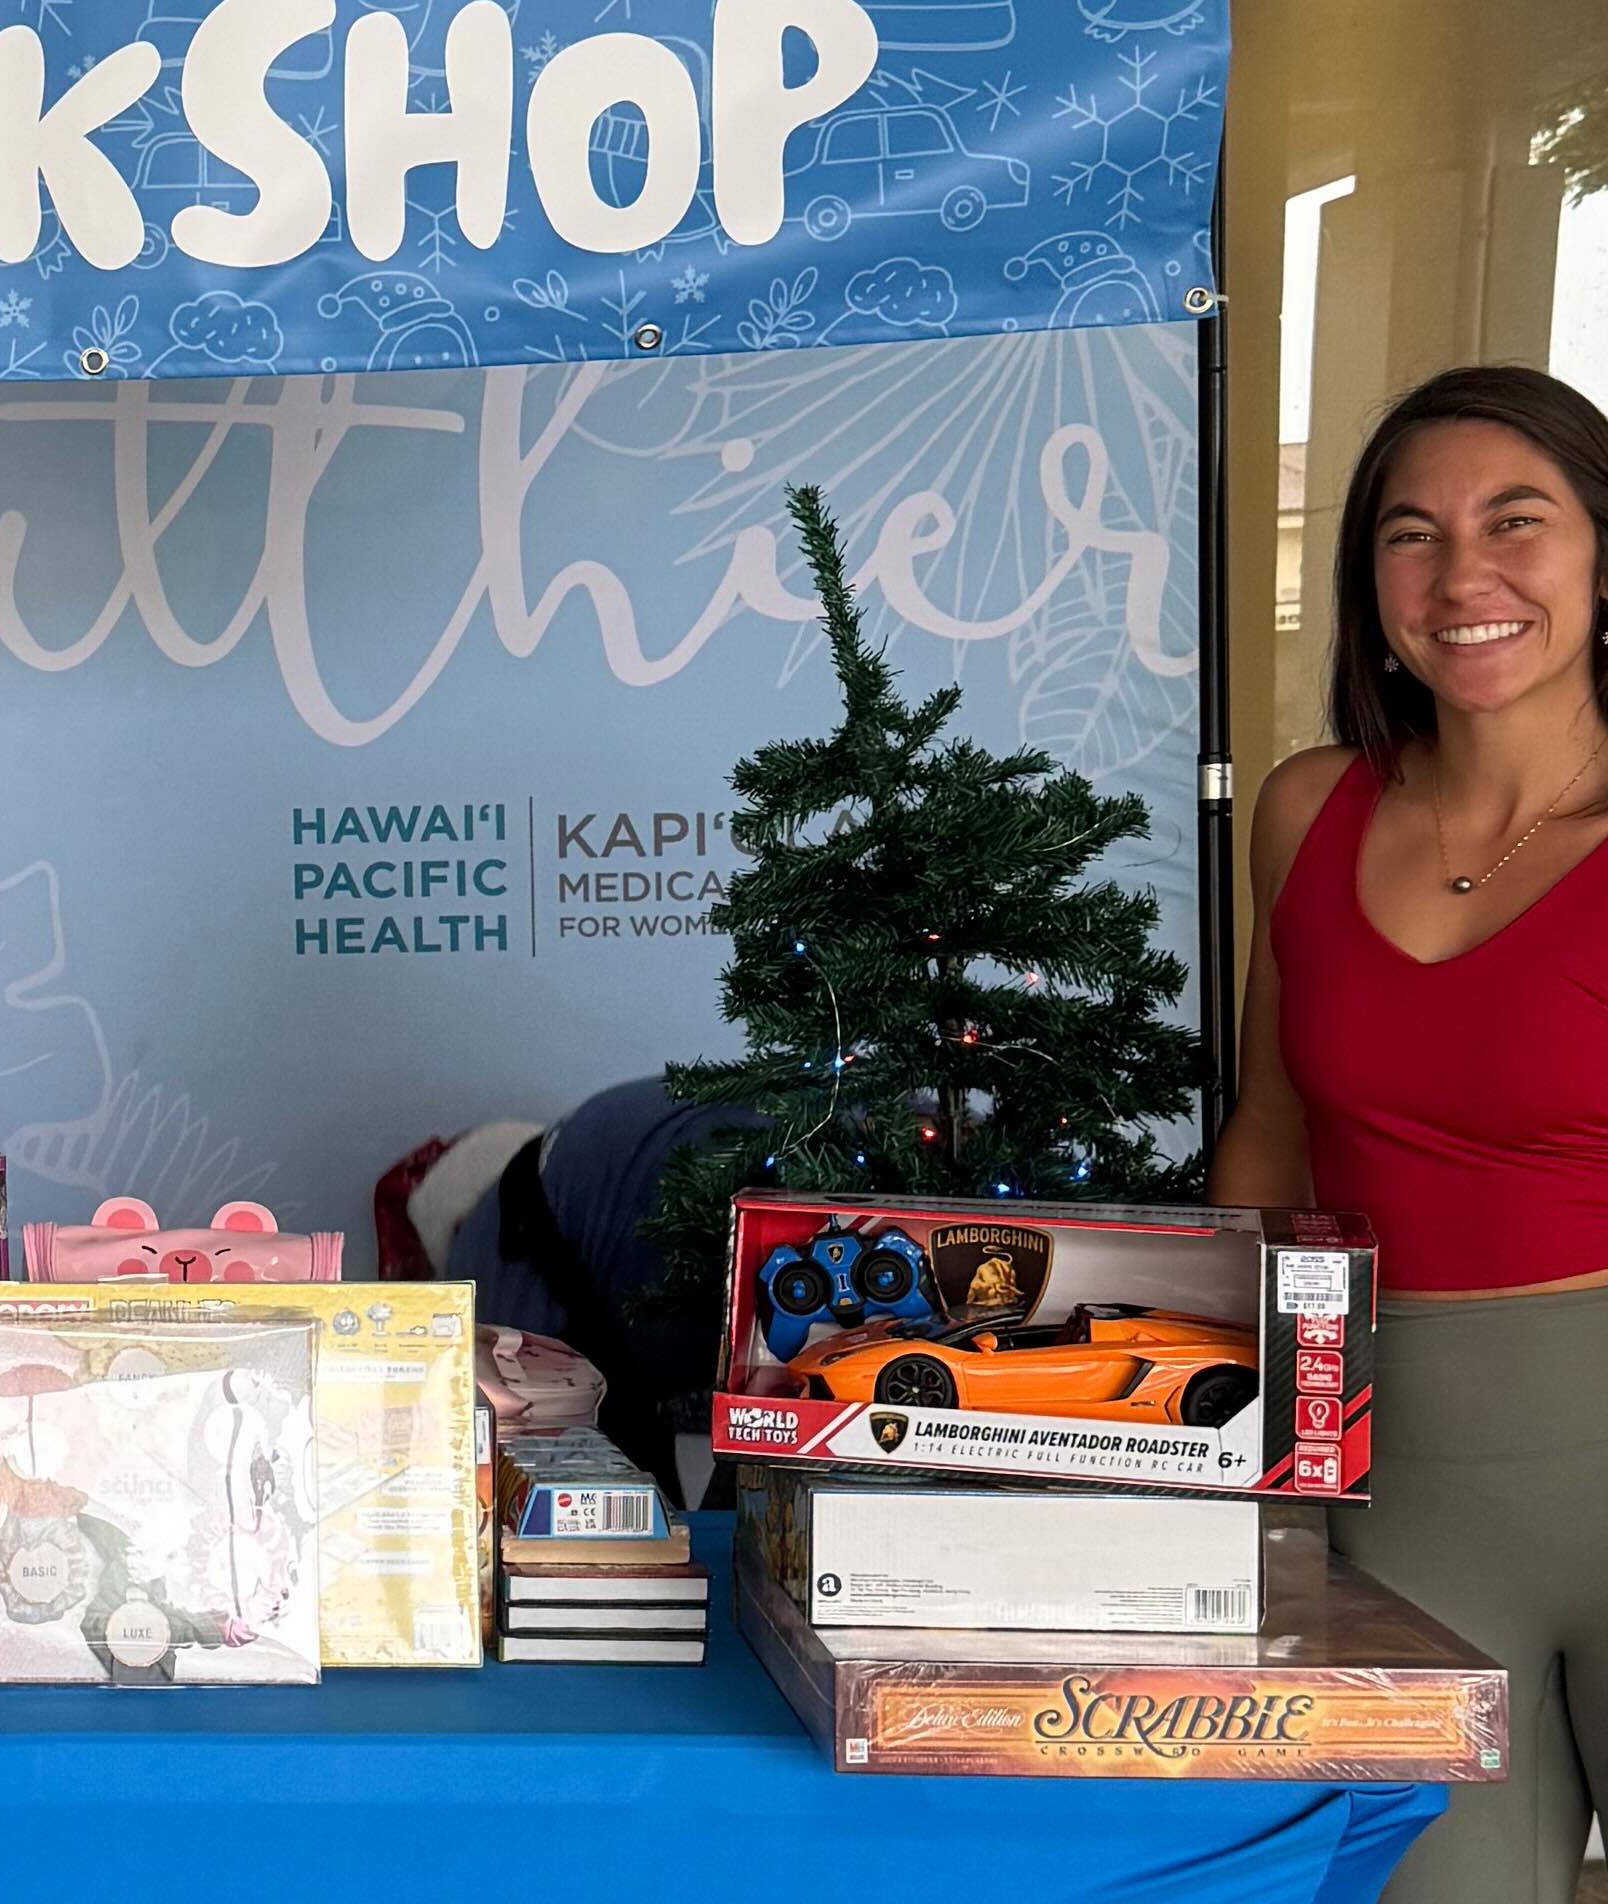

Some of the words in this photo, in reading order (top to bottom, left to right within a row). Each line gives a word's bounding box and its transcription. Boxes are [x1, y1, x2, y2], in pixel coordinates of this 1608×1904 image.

[294, 858, 508, 900] PACIFIC
[559, 870, 728, 903] MEDICA
[295, 914, 508, 955] HEALTH
[560, 916, 621, 938] FOR
[634, 915, 727, 937] WOM
[937, 1227, 1044, 1253] LAMBORGHINI
[729, 1408, 799, 1429] WORLD
[729, 1427, 761, 1441] TECH
[765, 1429, 798, 1445] TOYS
[914, 1421, 1025, 1445] LAMBORGHINI
[1028, 1429, 1122, 1452] AVENTADOR
[1125, 1438, 1210, 1458] ROADSTER
[914, 1442, 943, 1453] 1:14
[951, 1444, 1018, 1459] ELECTRIC
[1027, 1451, 1061, 1463] FULL
[1070, 1453, 1142, 1469] FUNCTION
[1151, 1459, 1168, 1472] RC
[1177, 1462, 1205, 1474] CAR
[1217, 1451, 1248, 1469] 6+
[22, 1566, 57, 1577] BASIC
[123, 1628, 152, 1639] LUXE
[962, 1705, 1024, 1728] Edition
[1034, 1674, 1315, 1759] SCRABBLE
[1041, 1746, 1201, 1757] CROSSWRD
[1238, 1748, 1306, 1757] GAME
